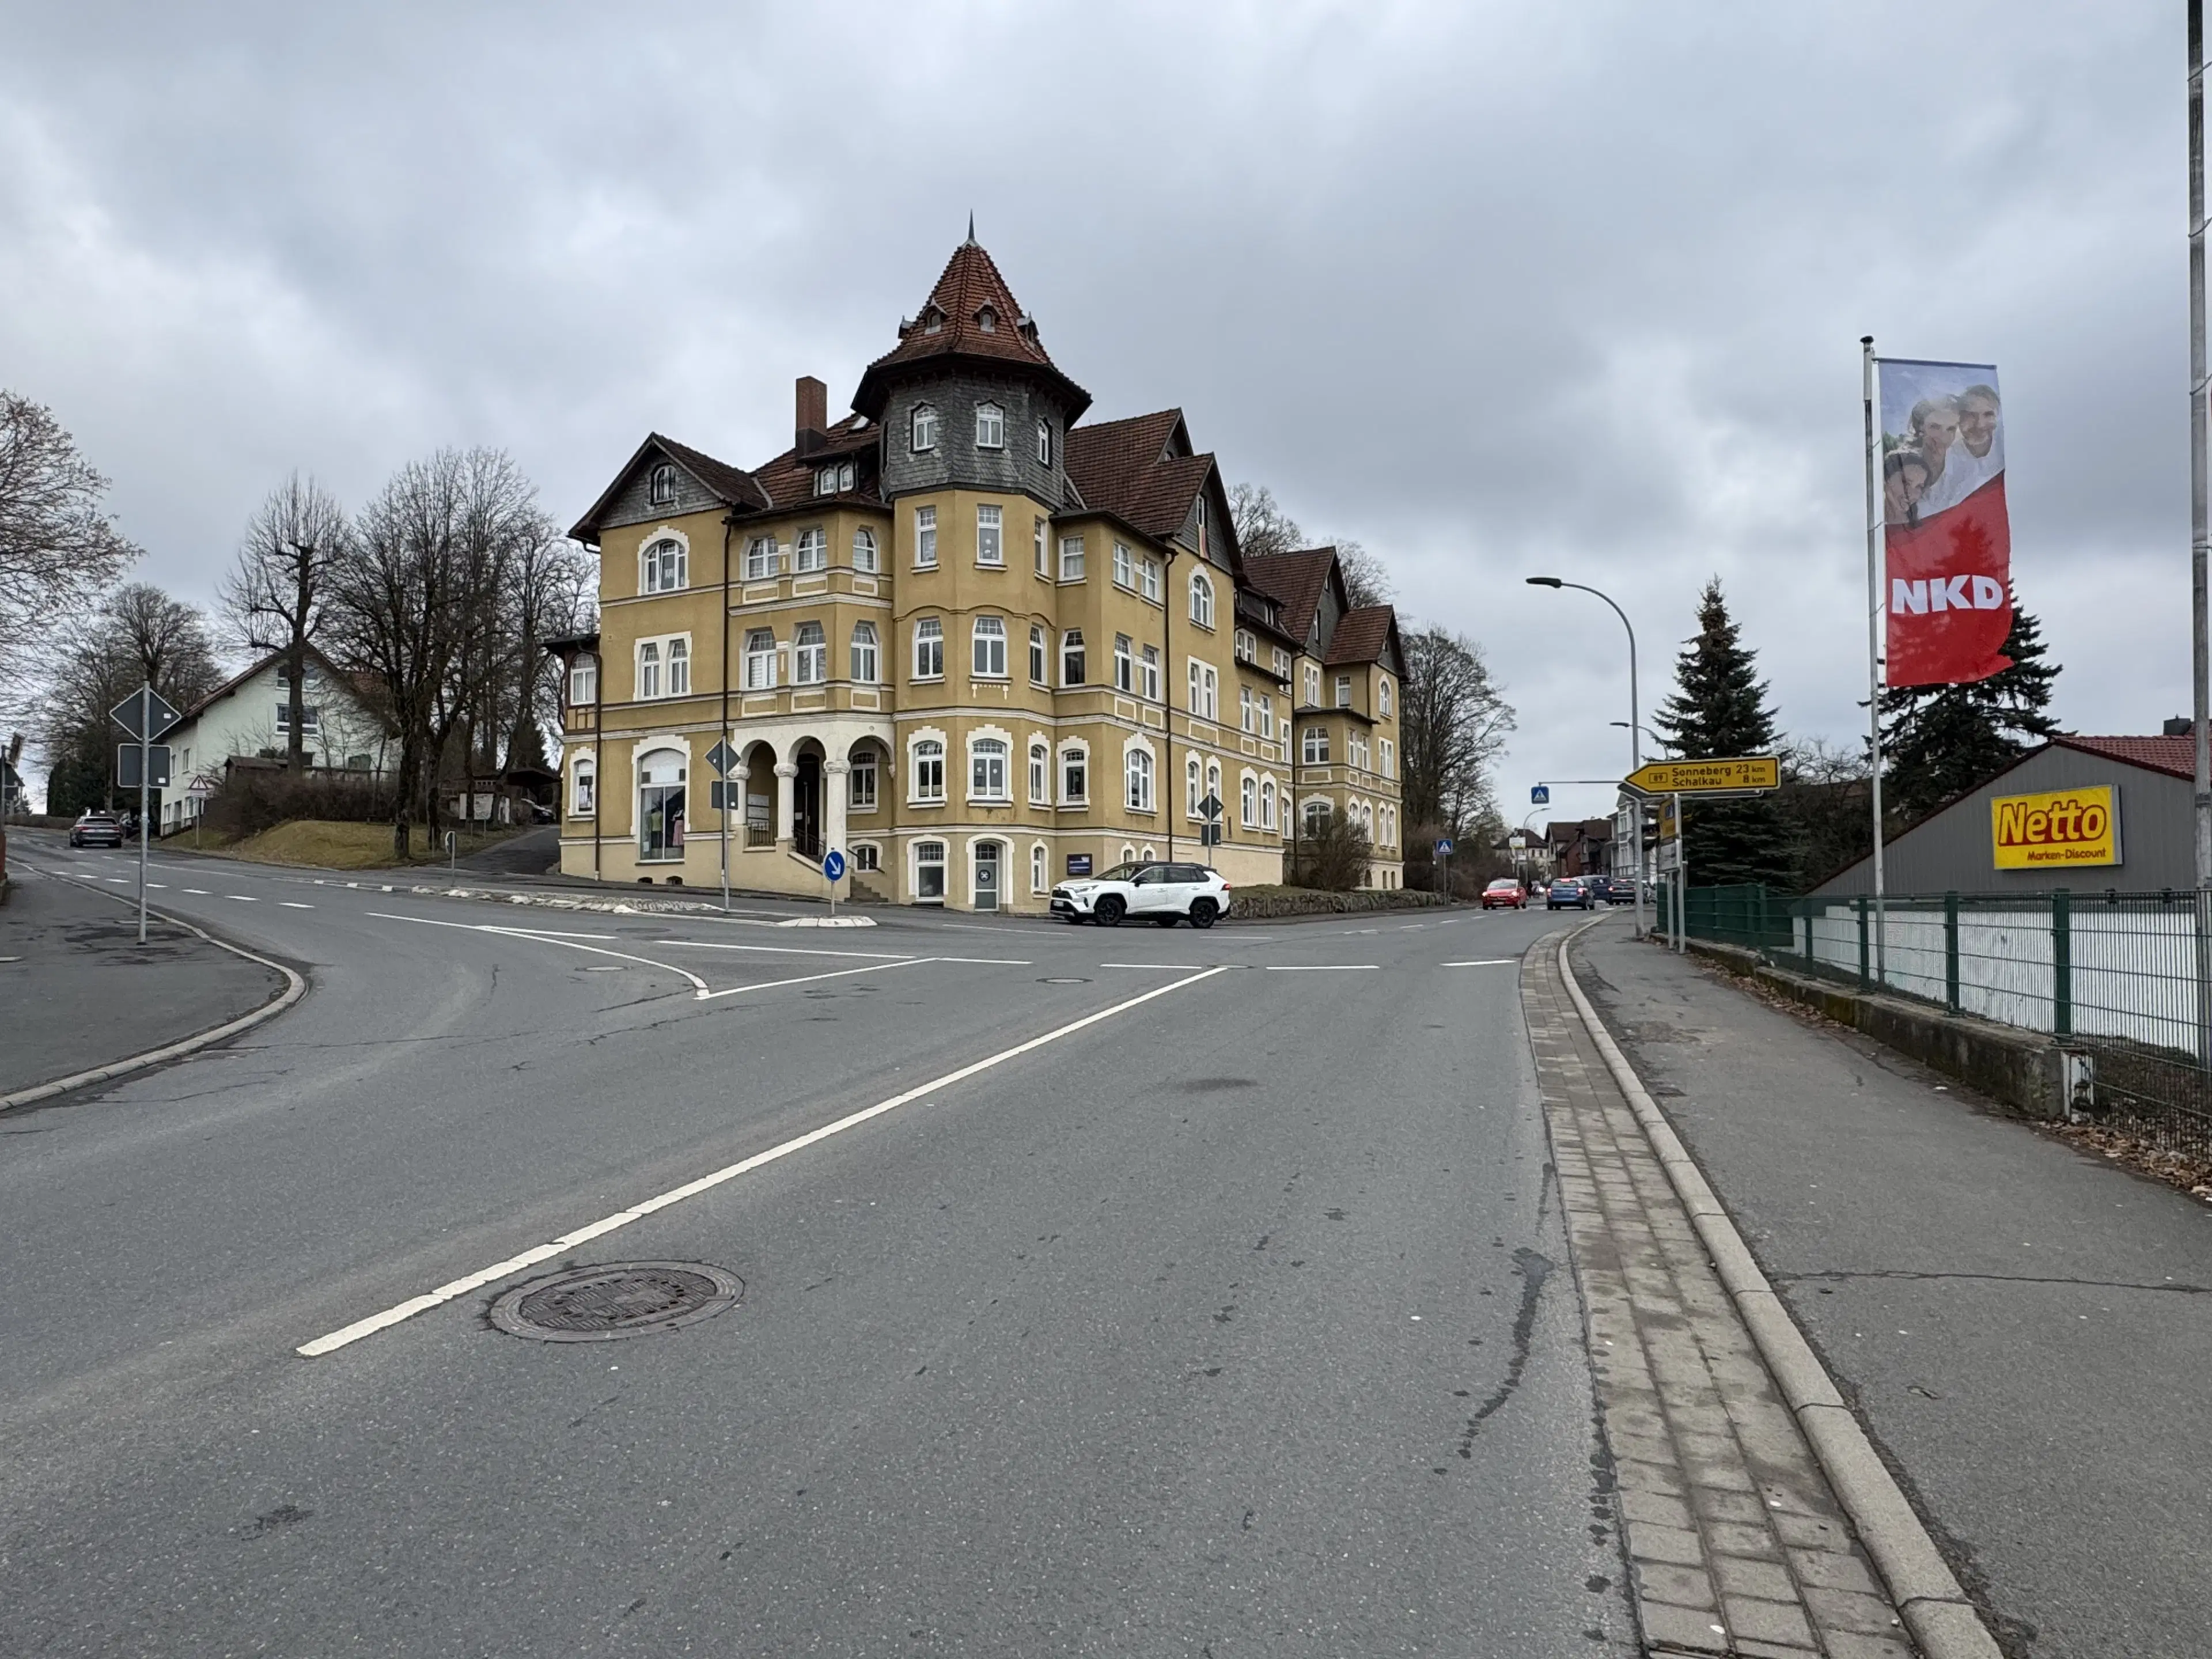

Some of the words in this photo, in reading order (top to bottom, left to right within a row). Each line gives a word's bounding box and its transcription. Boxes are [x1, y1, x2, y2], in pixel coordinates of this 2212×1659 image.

[1892, 574, 2003, 615] NKD
[1672, 766, 1731, 777] Sonneberg
[1736, 764, 1749, 774] 23
[1672, 777, 1722, 787] Schalkau
[1743, 774, 1749, 783] 8
[1998, 799, 2107, 846] Netto
[2027, 847, 2106, 861] Marken-Discount
